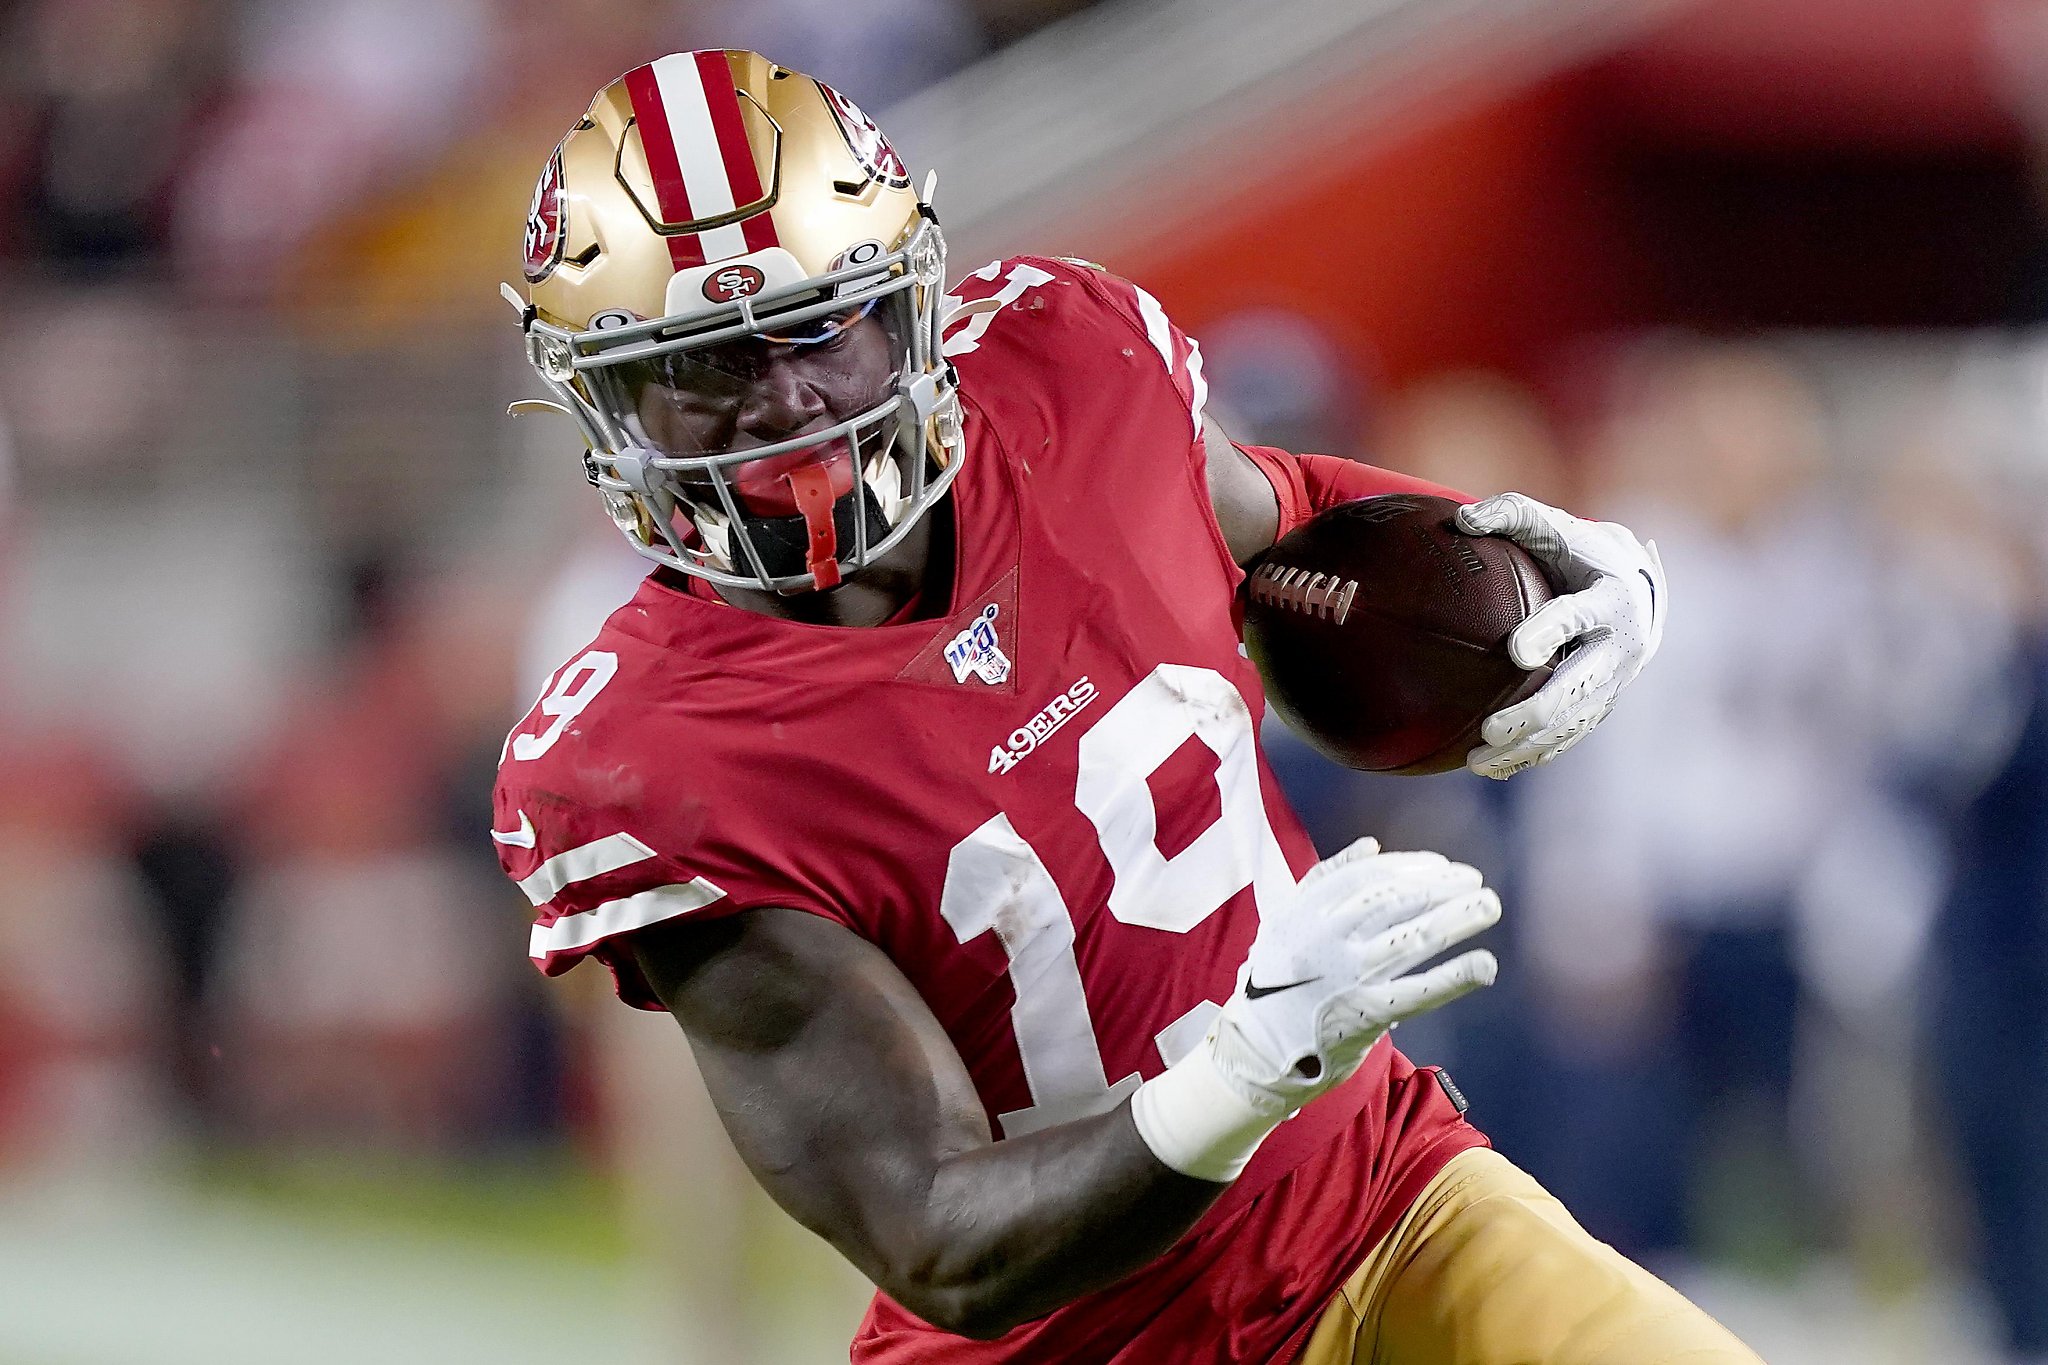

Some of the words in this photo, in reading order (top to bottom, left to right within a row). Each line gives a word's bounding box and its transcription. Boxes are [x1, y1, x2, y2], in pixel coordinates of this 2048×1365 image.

[716, 268, 757, 300] SF
[986, 675, 1101, 776] 49ERS
[939, 662, 1298, 1142] 19
